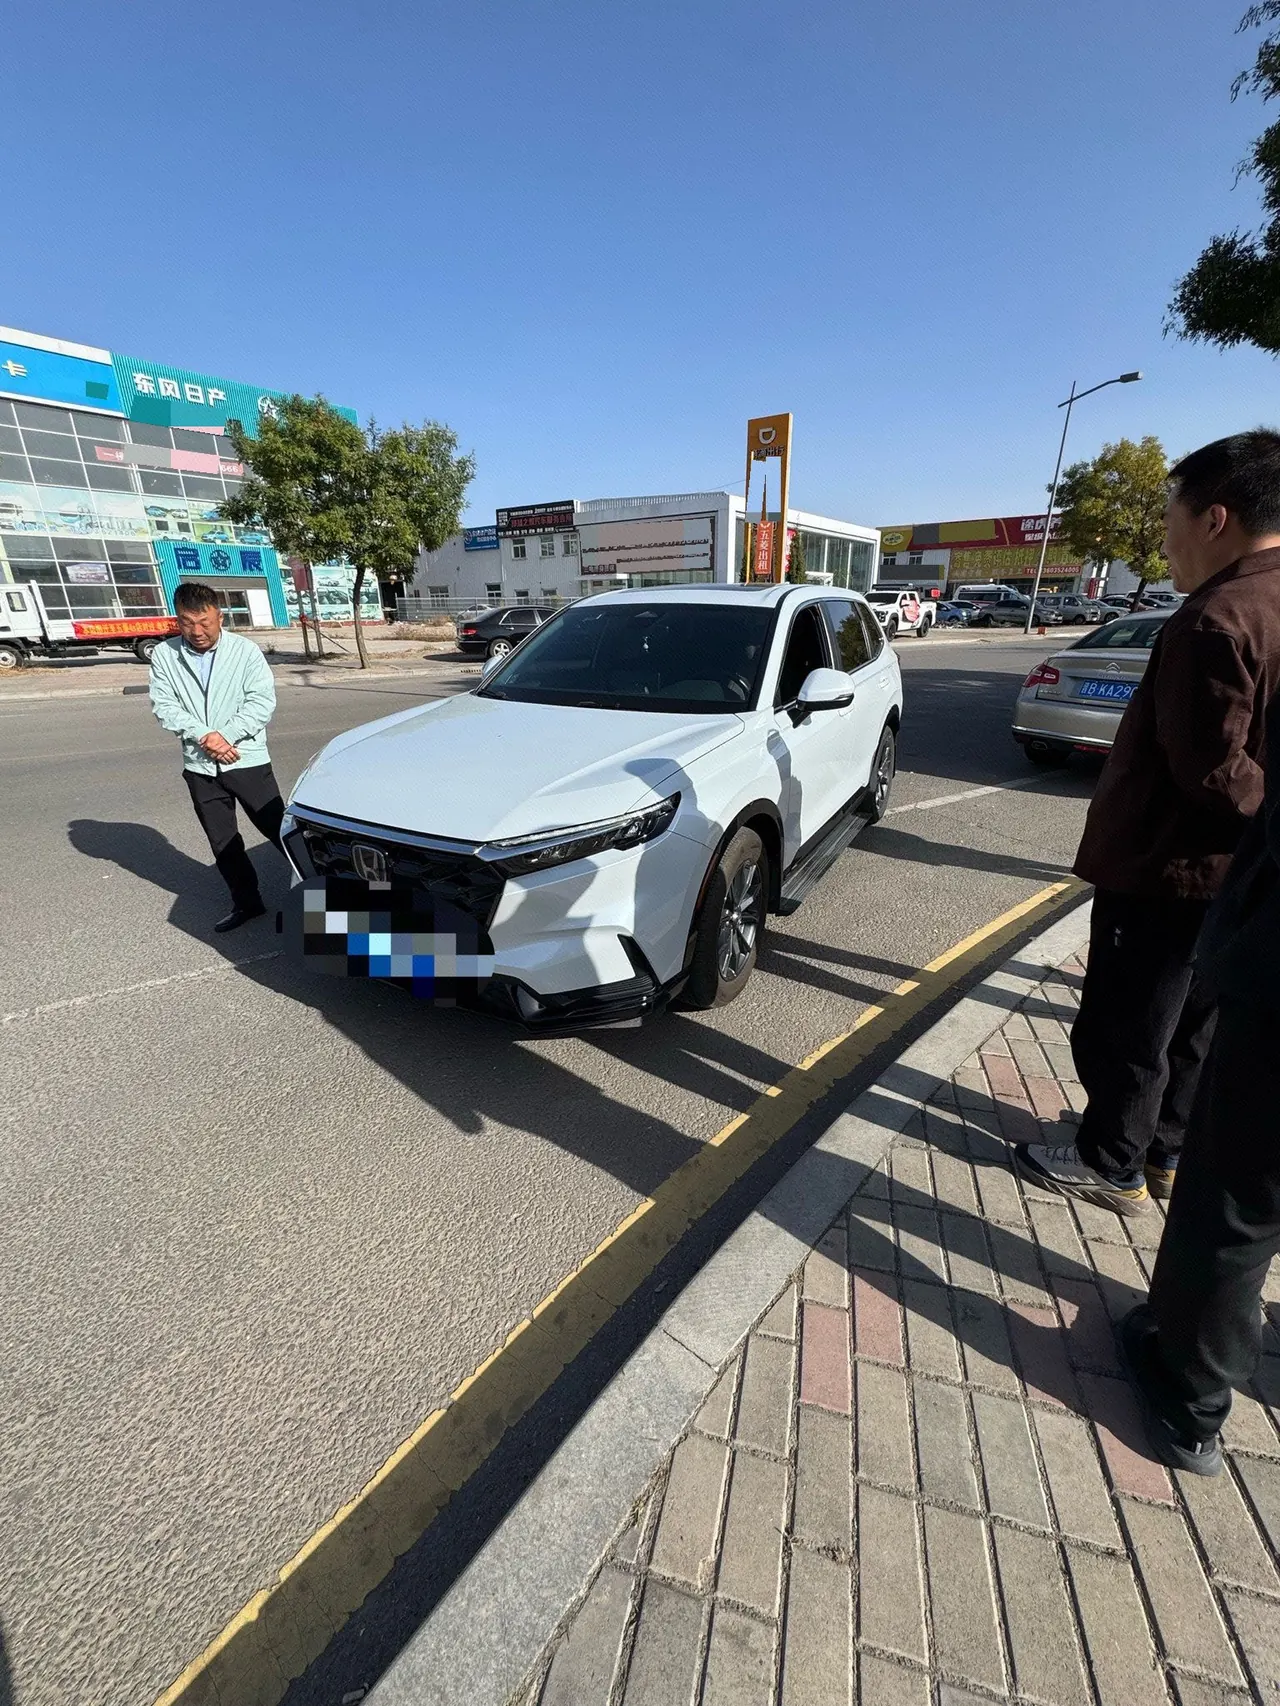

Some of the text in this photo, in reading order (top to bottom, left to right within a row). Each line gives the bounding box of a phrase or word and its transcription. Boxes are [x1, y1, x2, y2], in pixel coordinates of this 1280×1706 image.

[132, 372, 227, 407] 东风日产
[758, 529, 770, 570] 五菱出租
[1042, 567, 1080, 575] 3603524005
